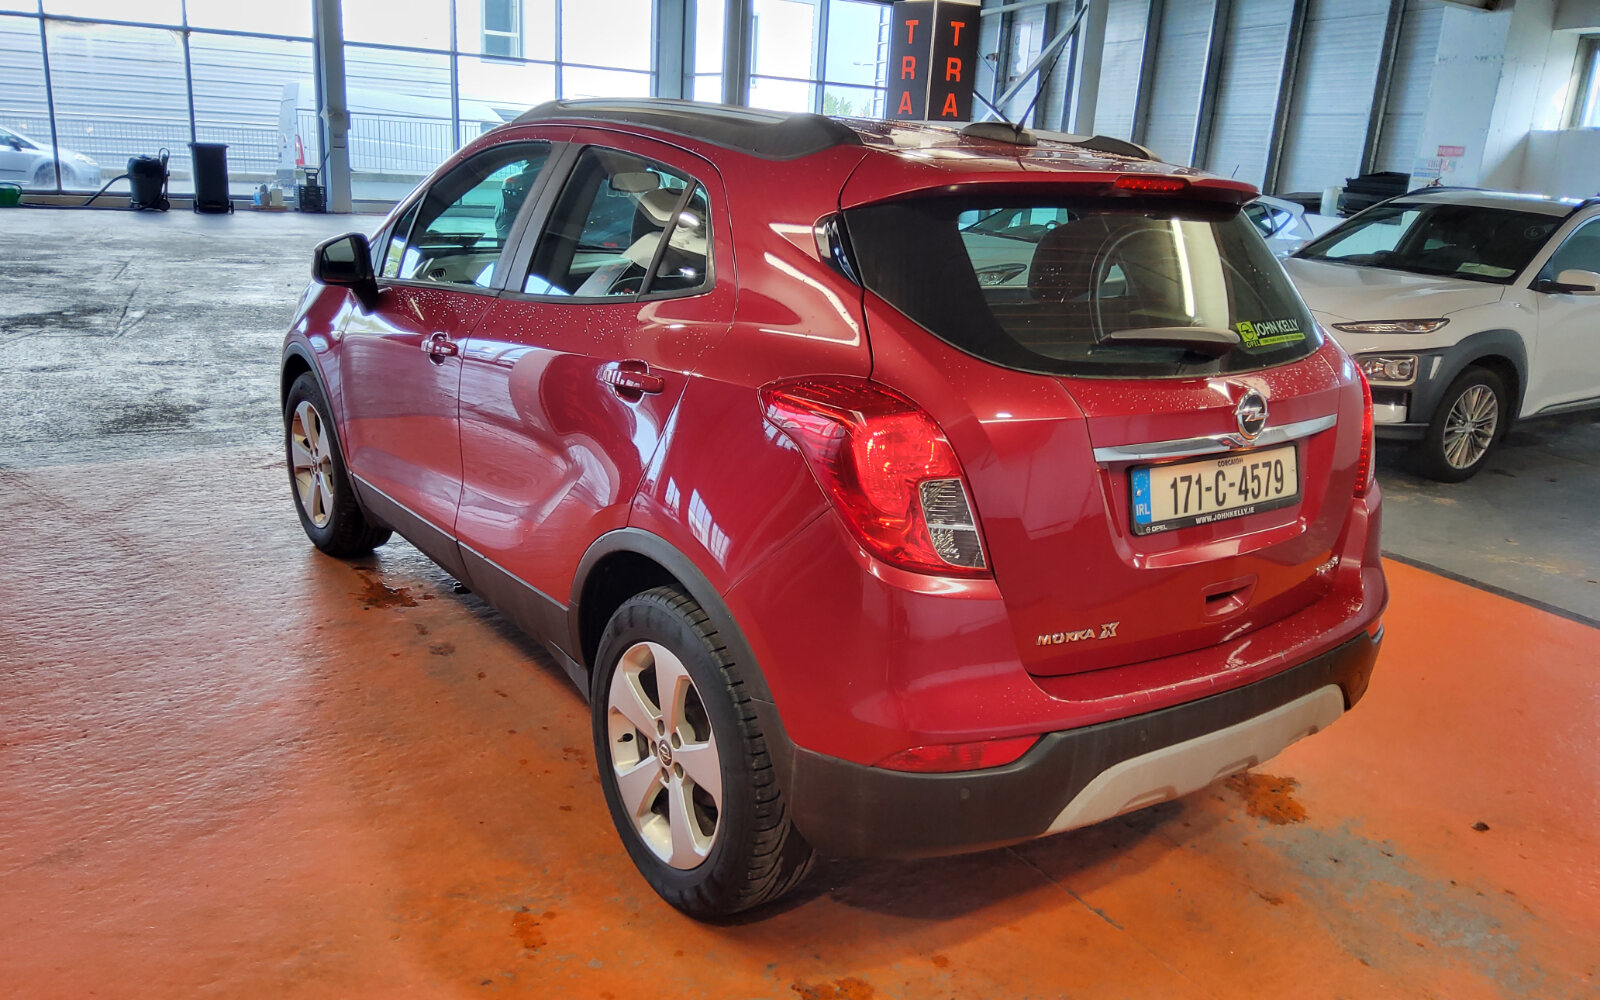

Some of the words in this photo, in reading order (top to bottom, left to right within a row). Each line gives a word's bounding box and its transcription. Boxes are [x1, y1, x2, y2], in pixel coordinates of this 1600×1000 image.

[1254, 322, 1279, 336] JOHN
[1277, 319, 1299, 333] KELLY
[1170, 459, 1284, 515] 171-C-4579
[1136, 503, 1150, 516] IRL
[1195, 506, 1254, 524] WWW.JOHNKELLY.IE
[1152, 524, 1168, 532] OPEL
[1036, 628, 1096, 645] MOKKA
[1099, 621, 1120, 639] X
